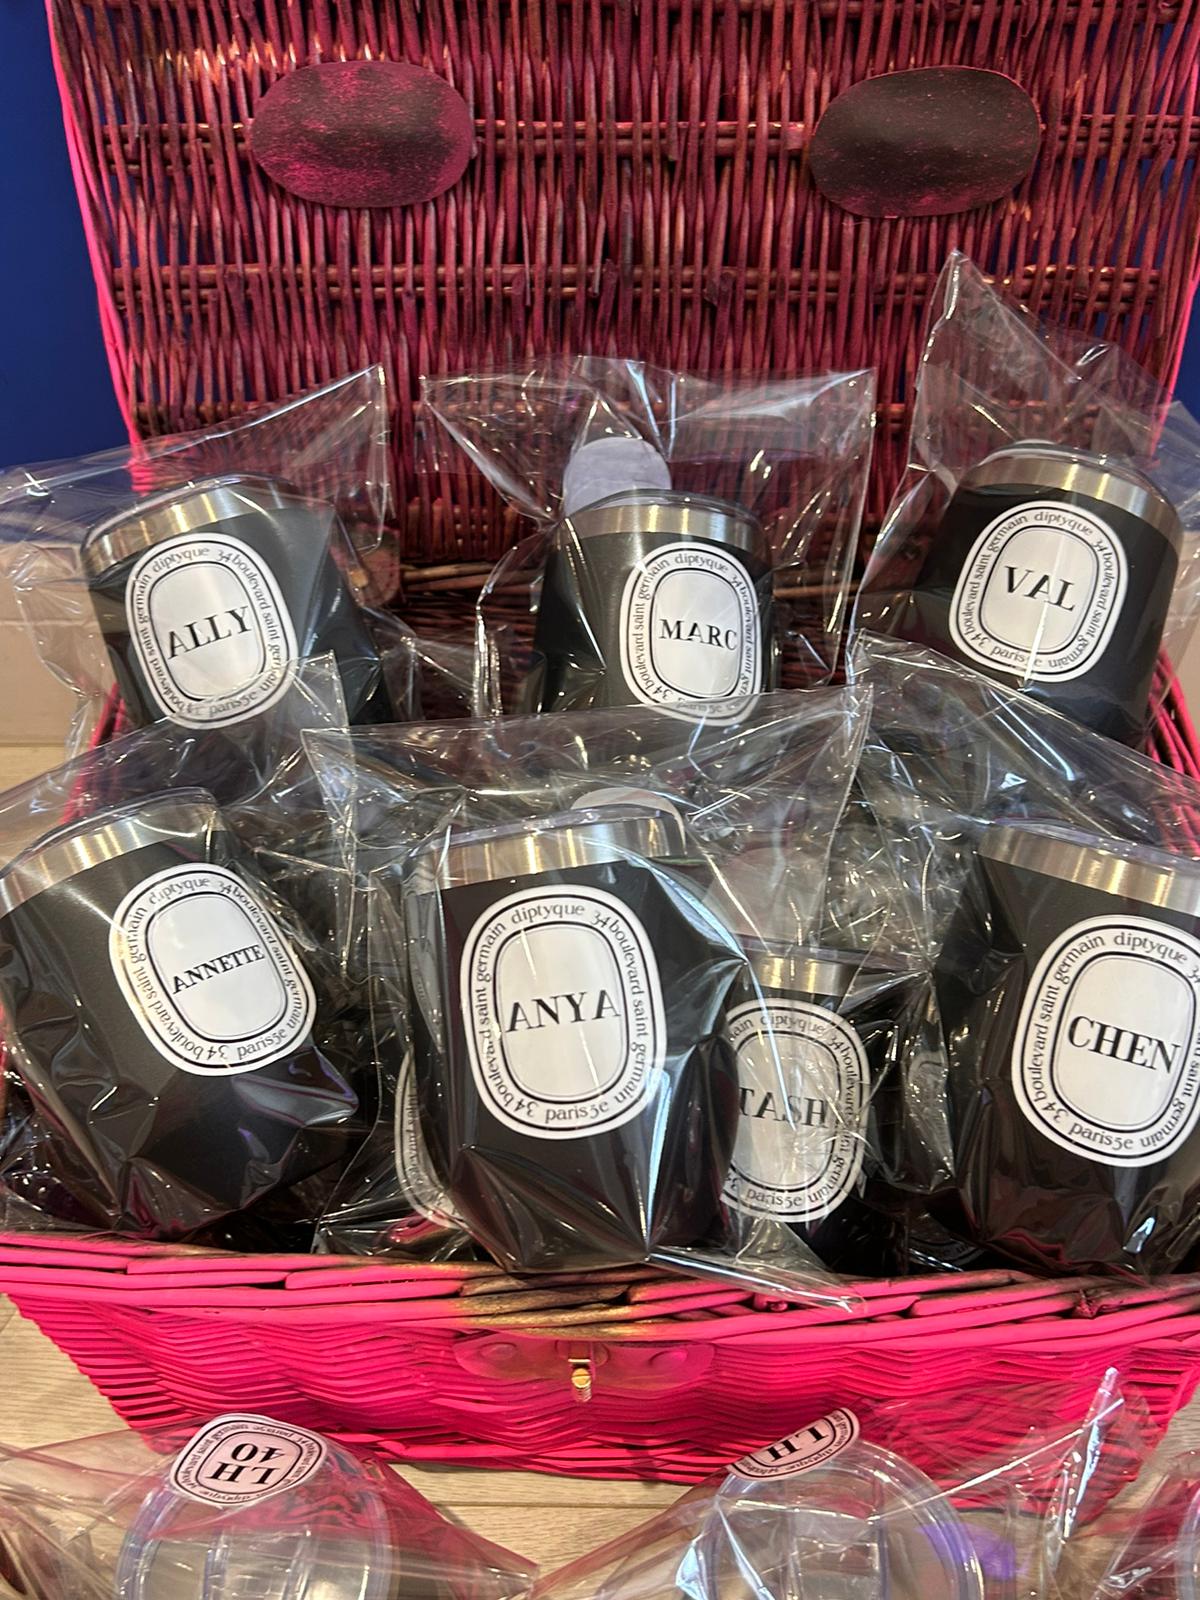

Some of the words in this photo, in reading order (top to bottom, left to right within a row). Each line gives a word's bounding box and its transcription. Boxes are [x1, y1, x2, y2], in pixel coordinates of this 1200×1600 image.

[1034, 511, 1093, 535] diptyque
[152, 547, 210, 573] diptyque
[674, 553, 729, 573] diptyque
[961, 581, 981, 636] boulevard
[974, 553, 992, 581] saint
[988, 514, 1029, 552] germain
[1004, 565, 1075, 612] VAL
[167, 605, 253, 660] ALLY
[262, 611, 281, 640] saint
[632, 603, 646, 630] saint
[658, 618, 738, 651] MARC
[1082, 610, 1103, 639] saint
[631, 632, 655, 690] boulevard
[511, 902, 586, 925] diptyque
[475, 922, 506, 984] germain
[608, 919, 646, 996] boulevard
[1054, 934, 1105, 985] germain
[1113, 931, 1188, 964] diptyque
[133, 966, 158, 1000] saint
[172, 944, 266, 995] ANNETTE
[475, 986, 490, 1024] saint
[505, 989, 621, 1033] ANYA
[633, 999, 649, 1038] saint
[1042, 984, 1061, 1023] saint
[151, 1000, 205, 1060] boulevard
[1067, 1015, 1181, 1074] CHEN
[615, 1041, 648, 1104] germain
[1027, 1023, 1049, 1103] boulevard
[1182, 1060, 1200, 1098] saint
[511, 1098, 540, 1119] 34
[739, 1086, 829, 1129] TASH
[1042, 1101, 1069, 1122] 34
[1141, 1097, 1186, 1149] germain
[231, 1442, 285, 1463] 40
[766, 1426, 829, 1462] LH
[206, 1461, 281, 1486] LH
